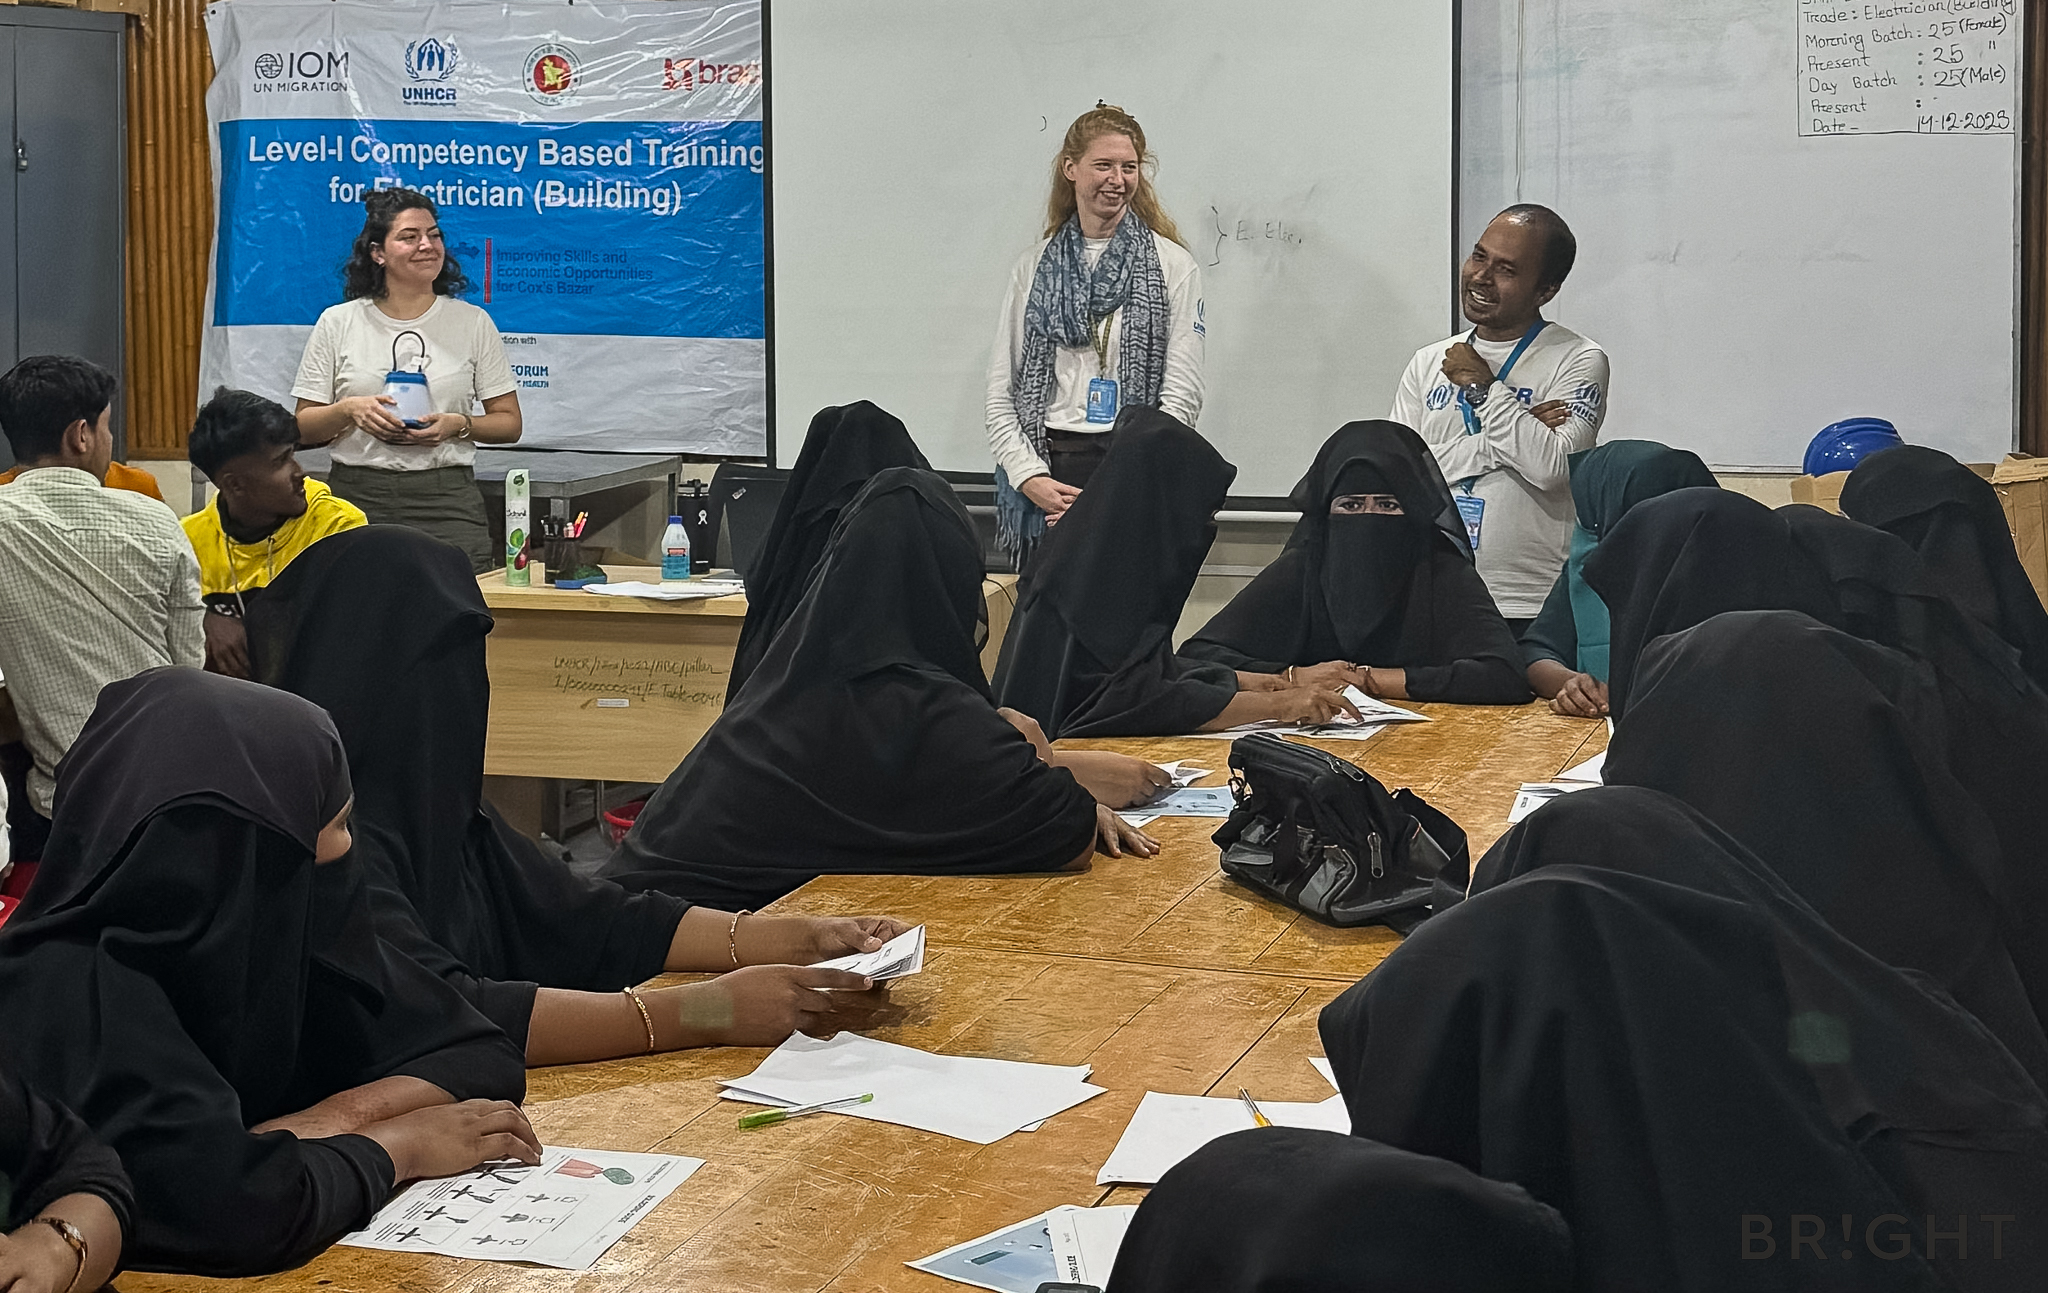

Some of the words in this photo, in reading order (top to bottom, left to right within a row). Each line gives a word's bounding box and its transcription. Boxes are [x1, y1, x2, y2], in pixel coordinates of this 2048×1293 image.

[1805, 33, 1865, 52] Morning
[1932, 43, 1964, 64] 25
[288, 51, 349, 79] IOM
[253, 83, 272, 93] UN
[277, 82, 348, 92] MIGRATION
[1809, 77, 1838, 95] Day
[1853, 70, 1898, 89] Batch
[402, 87, 457, 100] UNHCR
[351, 135, 529, 173] Competency
[538, 138, 633, 167] Based
[642, 138, 764, 174] Training
[329, 176, 365, 203] for
[533, 180, 682, 216] (Building)
[496, 250, 561, 266] Improving
[564, 250, 599, 264] Skills
[602, 250, 628, 264] and
[497, 264, 561, 278] Economic
[563, 266, 653, 282] Opportunities
[496, 281, 514, 293] for
[517, 280, 553, 295] Cox's
[557, 282, 595, 295] Bazar
